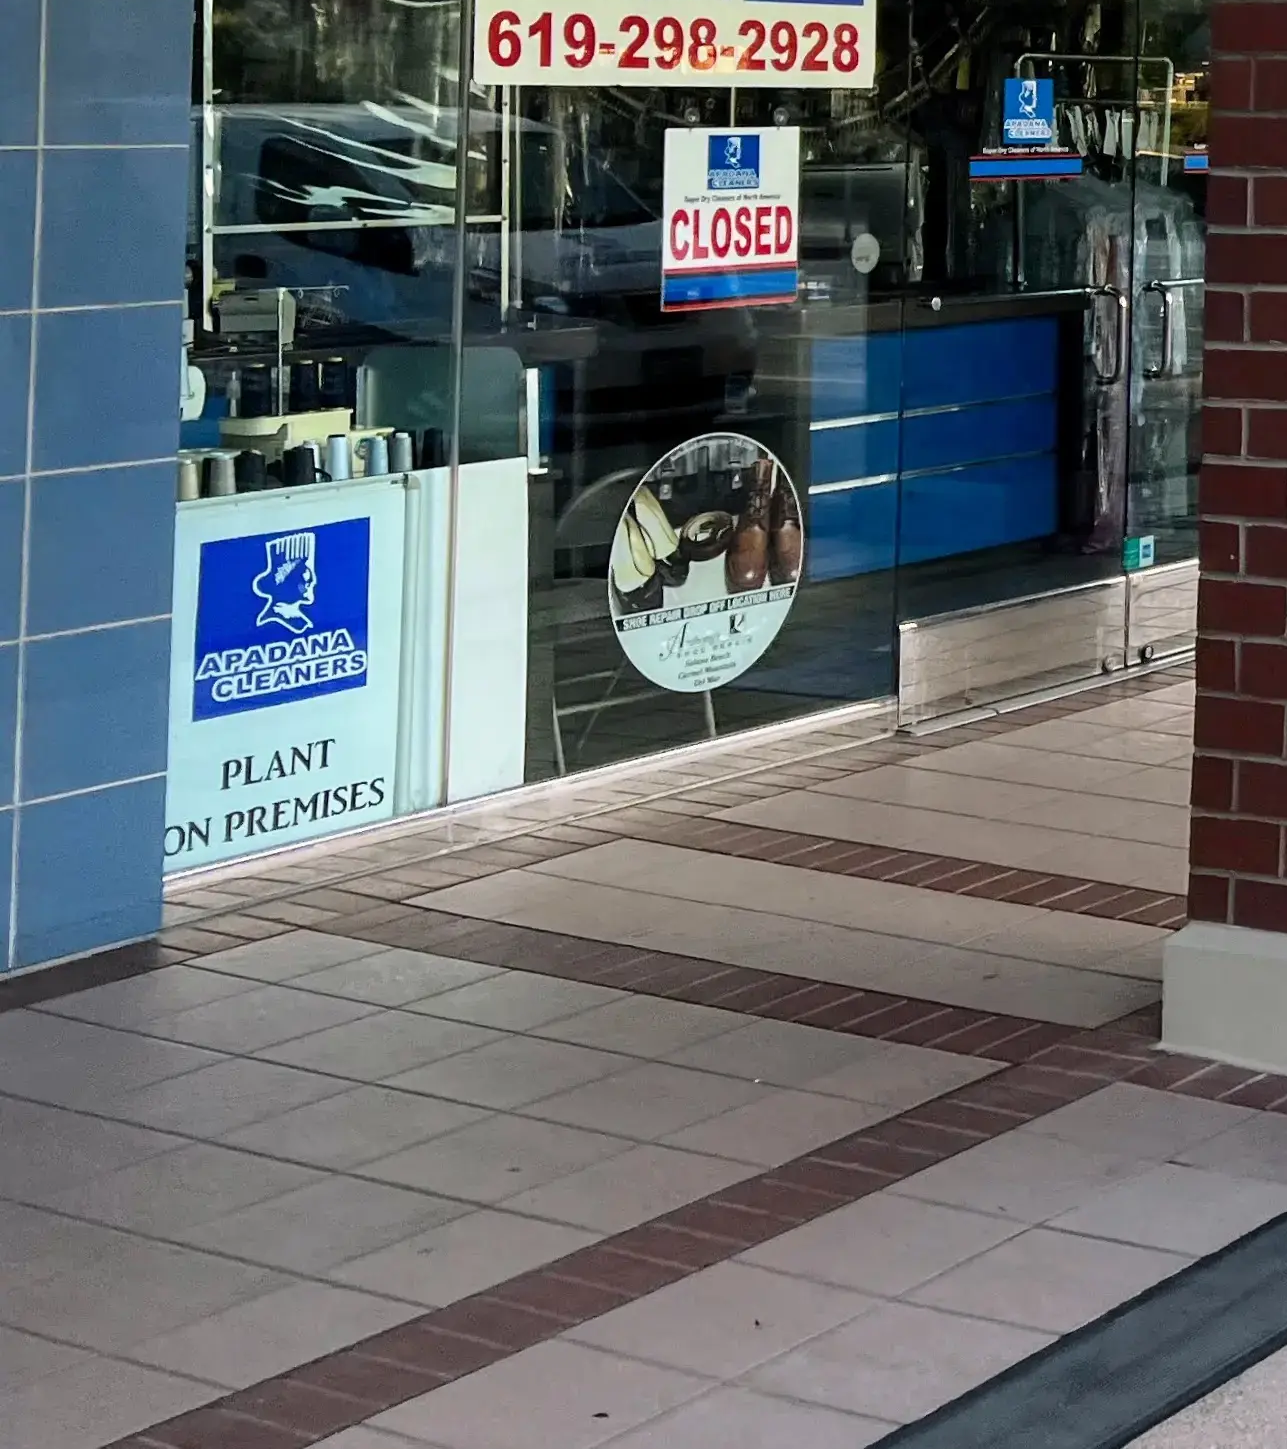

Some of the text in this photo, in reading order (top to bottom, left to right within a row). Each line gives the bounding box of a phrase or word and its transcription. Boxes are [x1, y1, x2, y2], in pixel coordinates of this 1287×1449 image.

[488, 10, 860, 75] 619-298-2928
[669, 205, 793, 261] CLOSED
[622, 615, 648, 631] SHOE
[649, 608, 681, 624] REPAIR
[709, 599, 726, 613] OFF
[727, 591, 768, 610] LOCATION
[769, 586, 792, 602] HERE
[194, 628, 355, 681] APADANA
[211, 650, 367, 702] CLEANERS
[220, 738, 336, 791] PLANT
[163, 777, 385, 856] ON PREMISES
